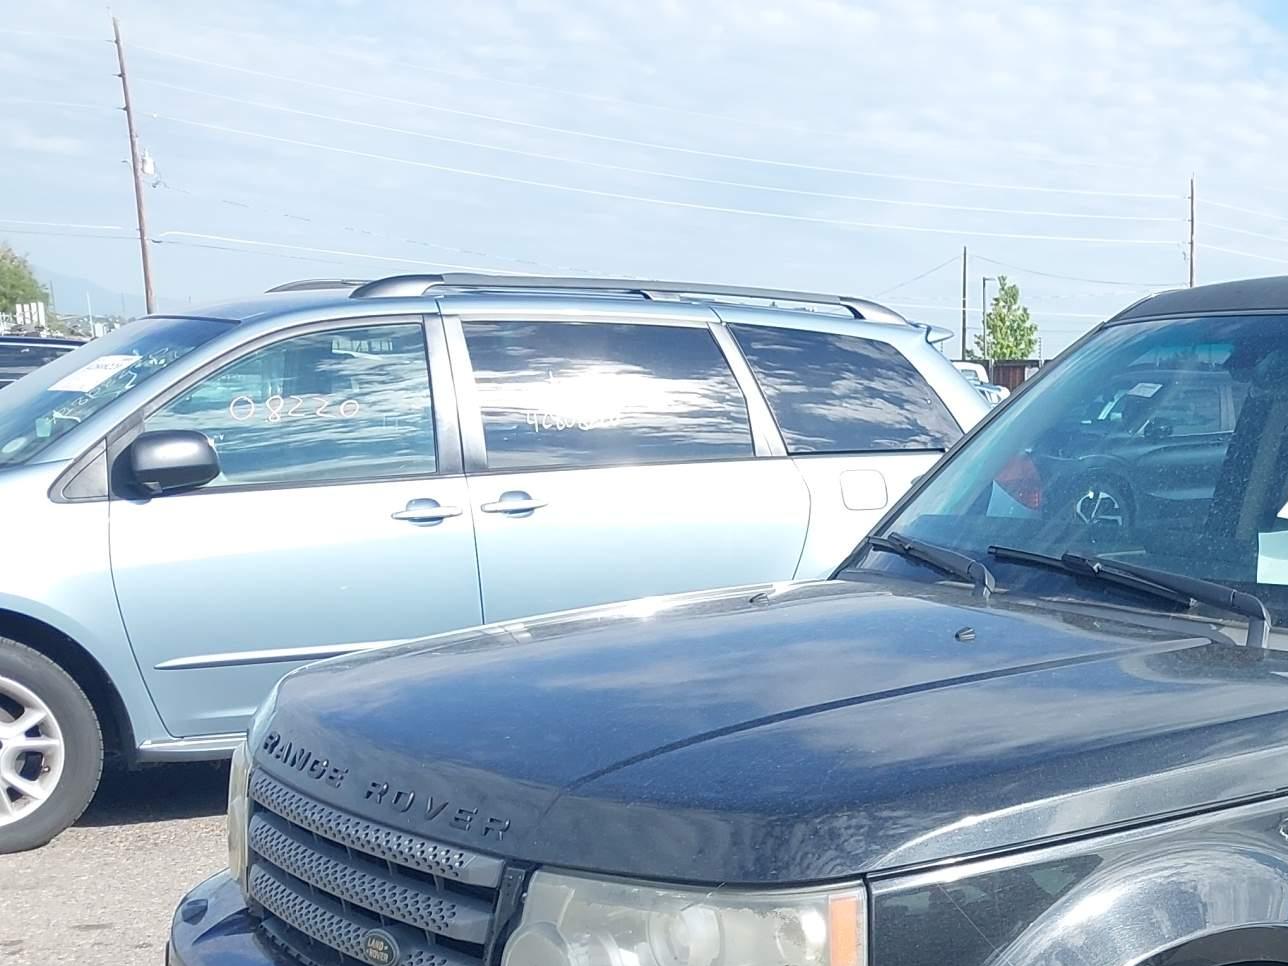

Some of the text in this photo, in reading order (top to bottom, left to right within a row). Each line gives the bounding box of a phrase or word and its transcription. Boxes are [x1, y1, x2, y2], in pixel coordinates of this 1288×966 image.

[229, 395, 360, 422] 08220
[263, 732, 511, 841] RANGE ROVER
